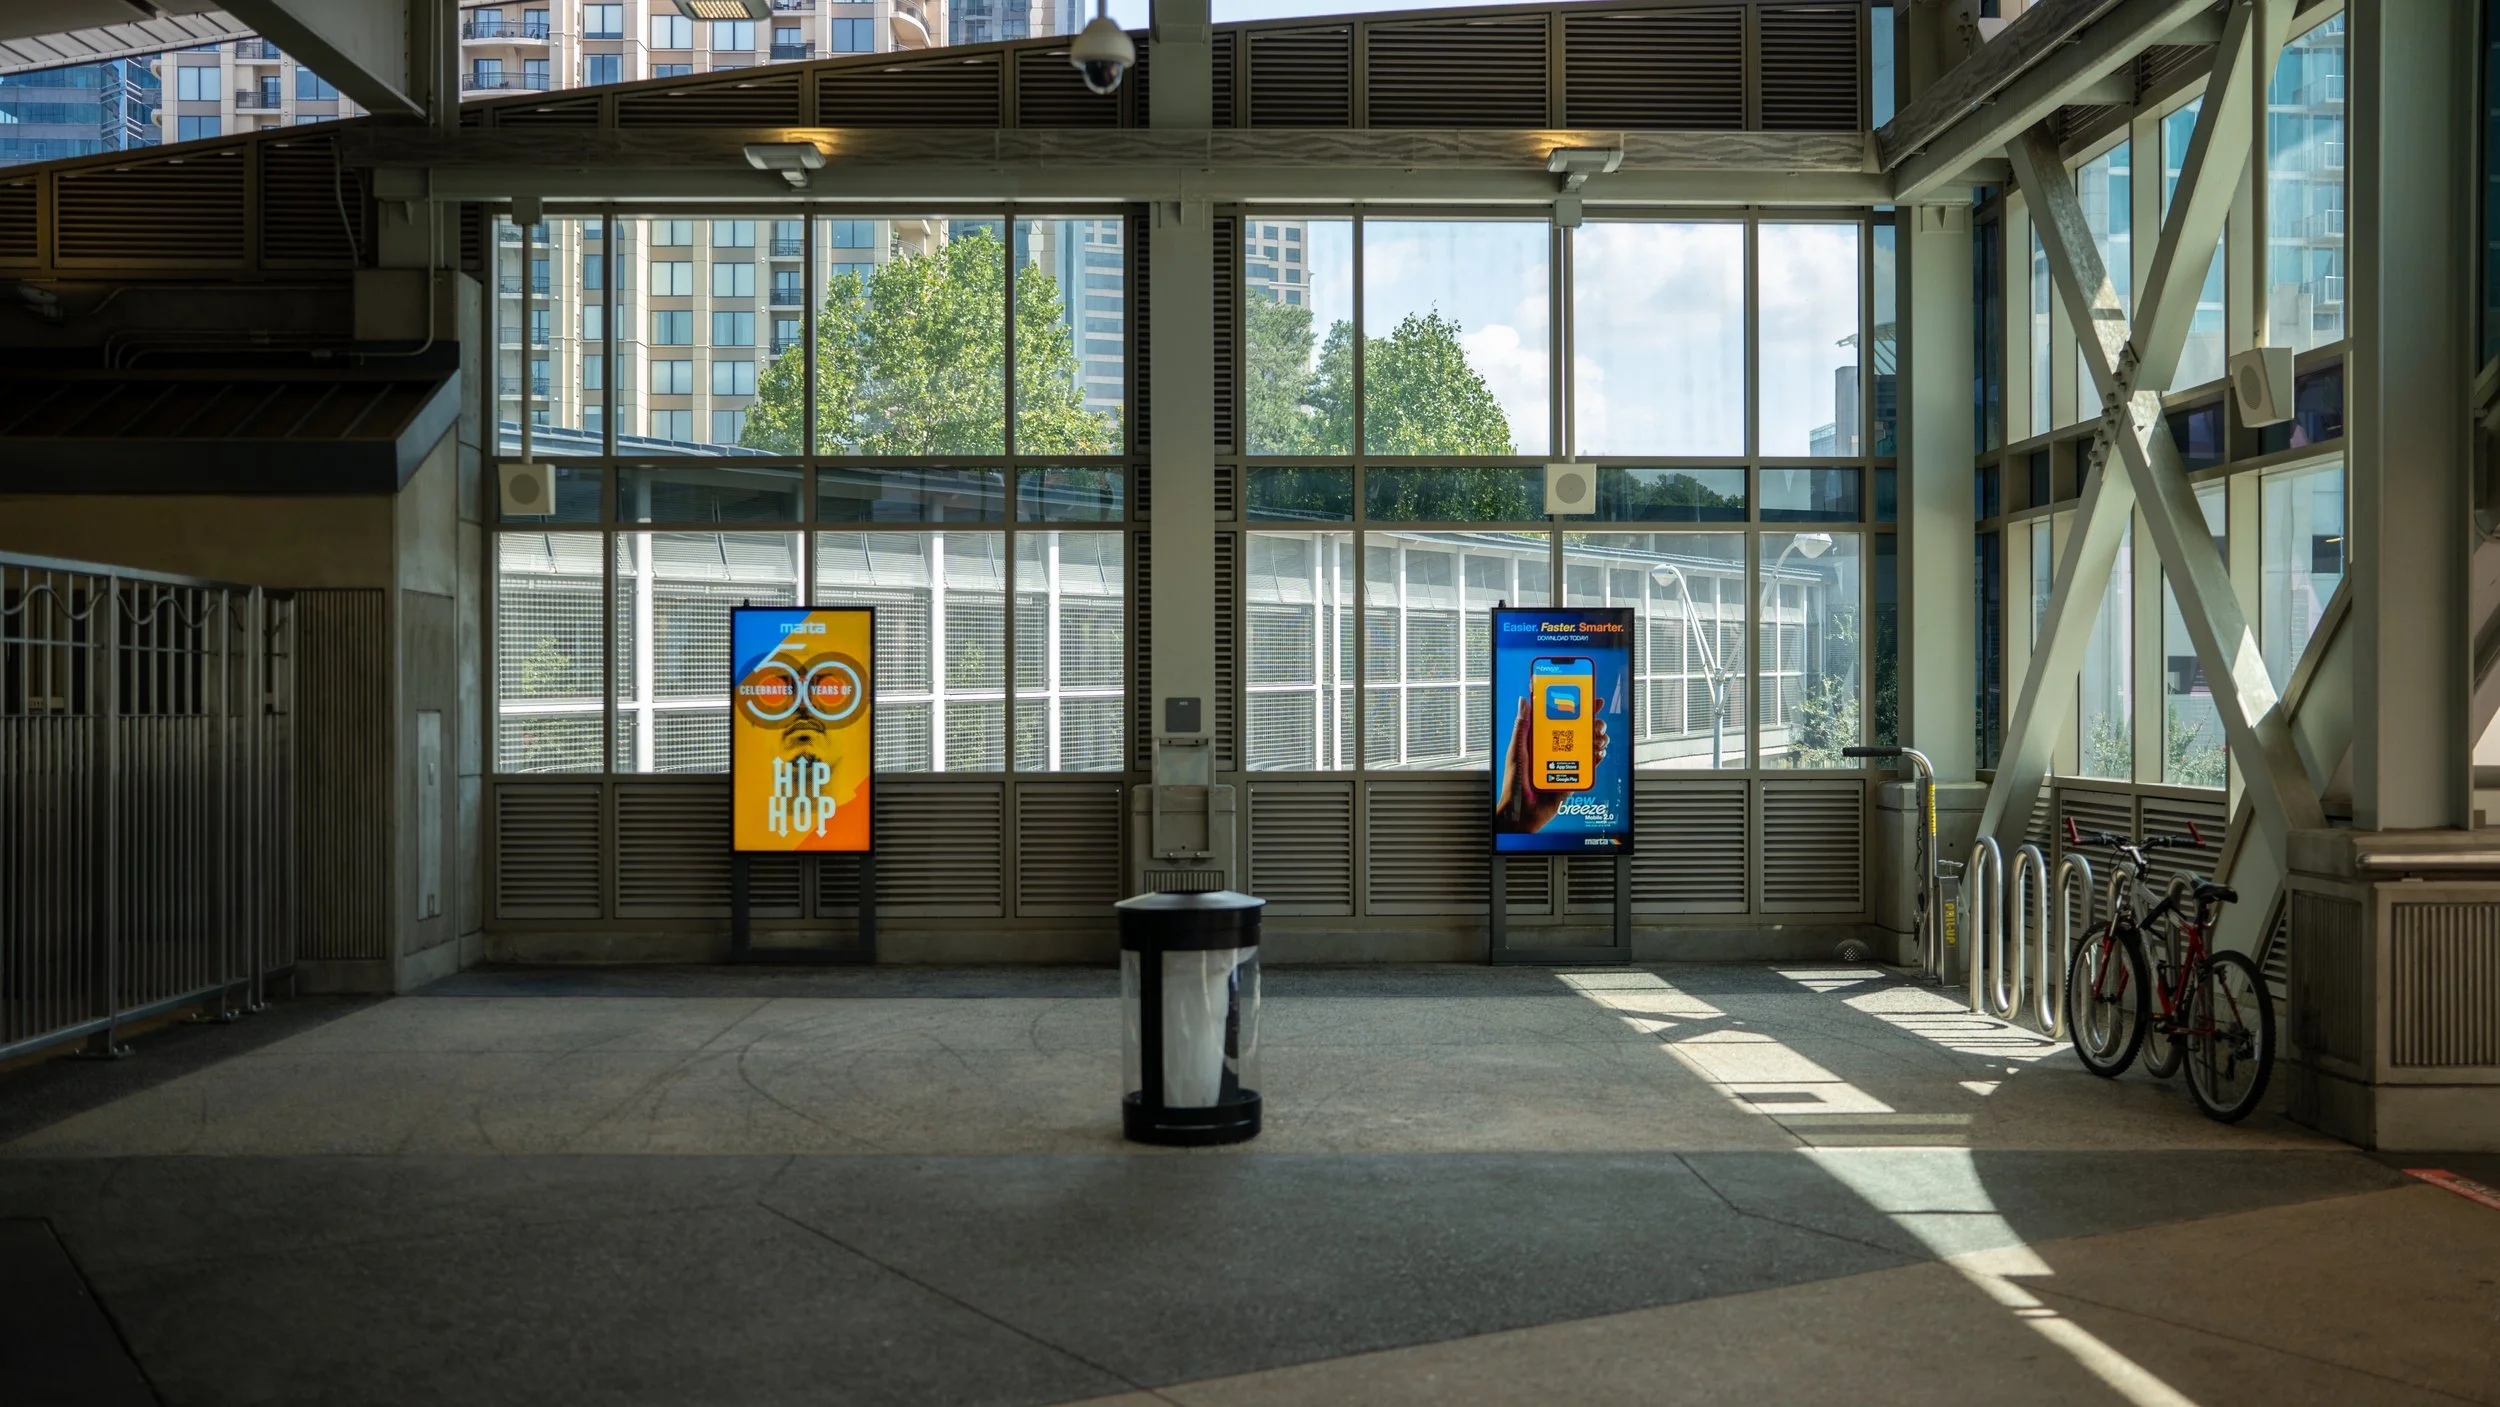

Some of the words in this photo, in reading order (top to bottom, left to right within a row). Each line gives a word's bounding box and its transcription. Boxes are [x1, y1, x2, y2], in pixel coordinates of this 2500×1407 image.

[780, 622, 826, 634] marta
[1503, 622, 1538, 632] Easier.
[1541, 622, 1576, 632] Faster.
[1579, 622, 1624, 632] Smarter.
[746, 643, 862, 721] 50
[739, 685, 793, 695] CELEBRATES
[811, 685, 839, 695] YEARS
[842, 685, 853, 695] OF
[772, 756, 831, 798] HIP
[1566, 796, 1596, 805] new
[1557, 800, 1606, 815] breeze
[768, 796, 836, 838] HOP
